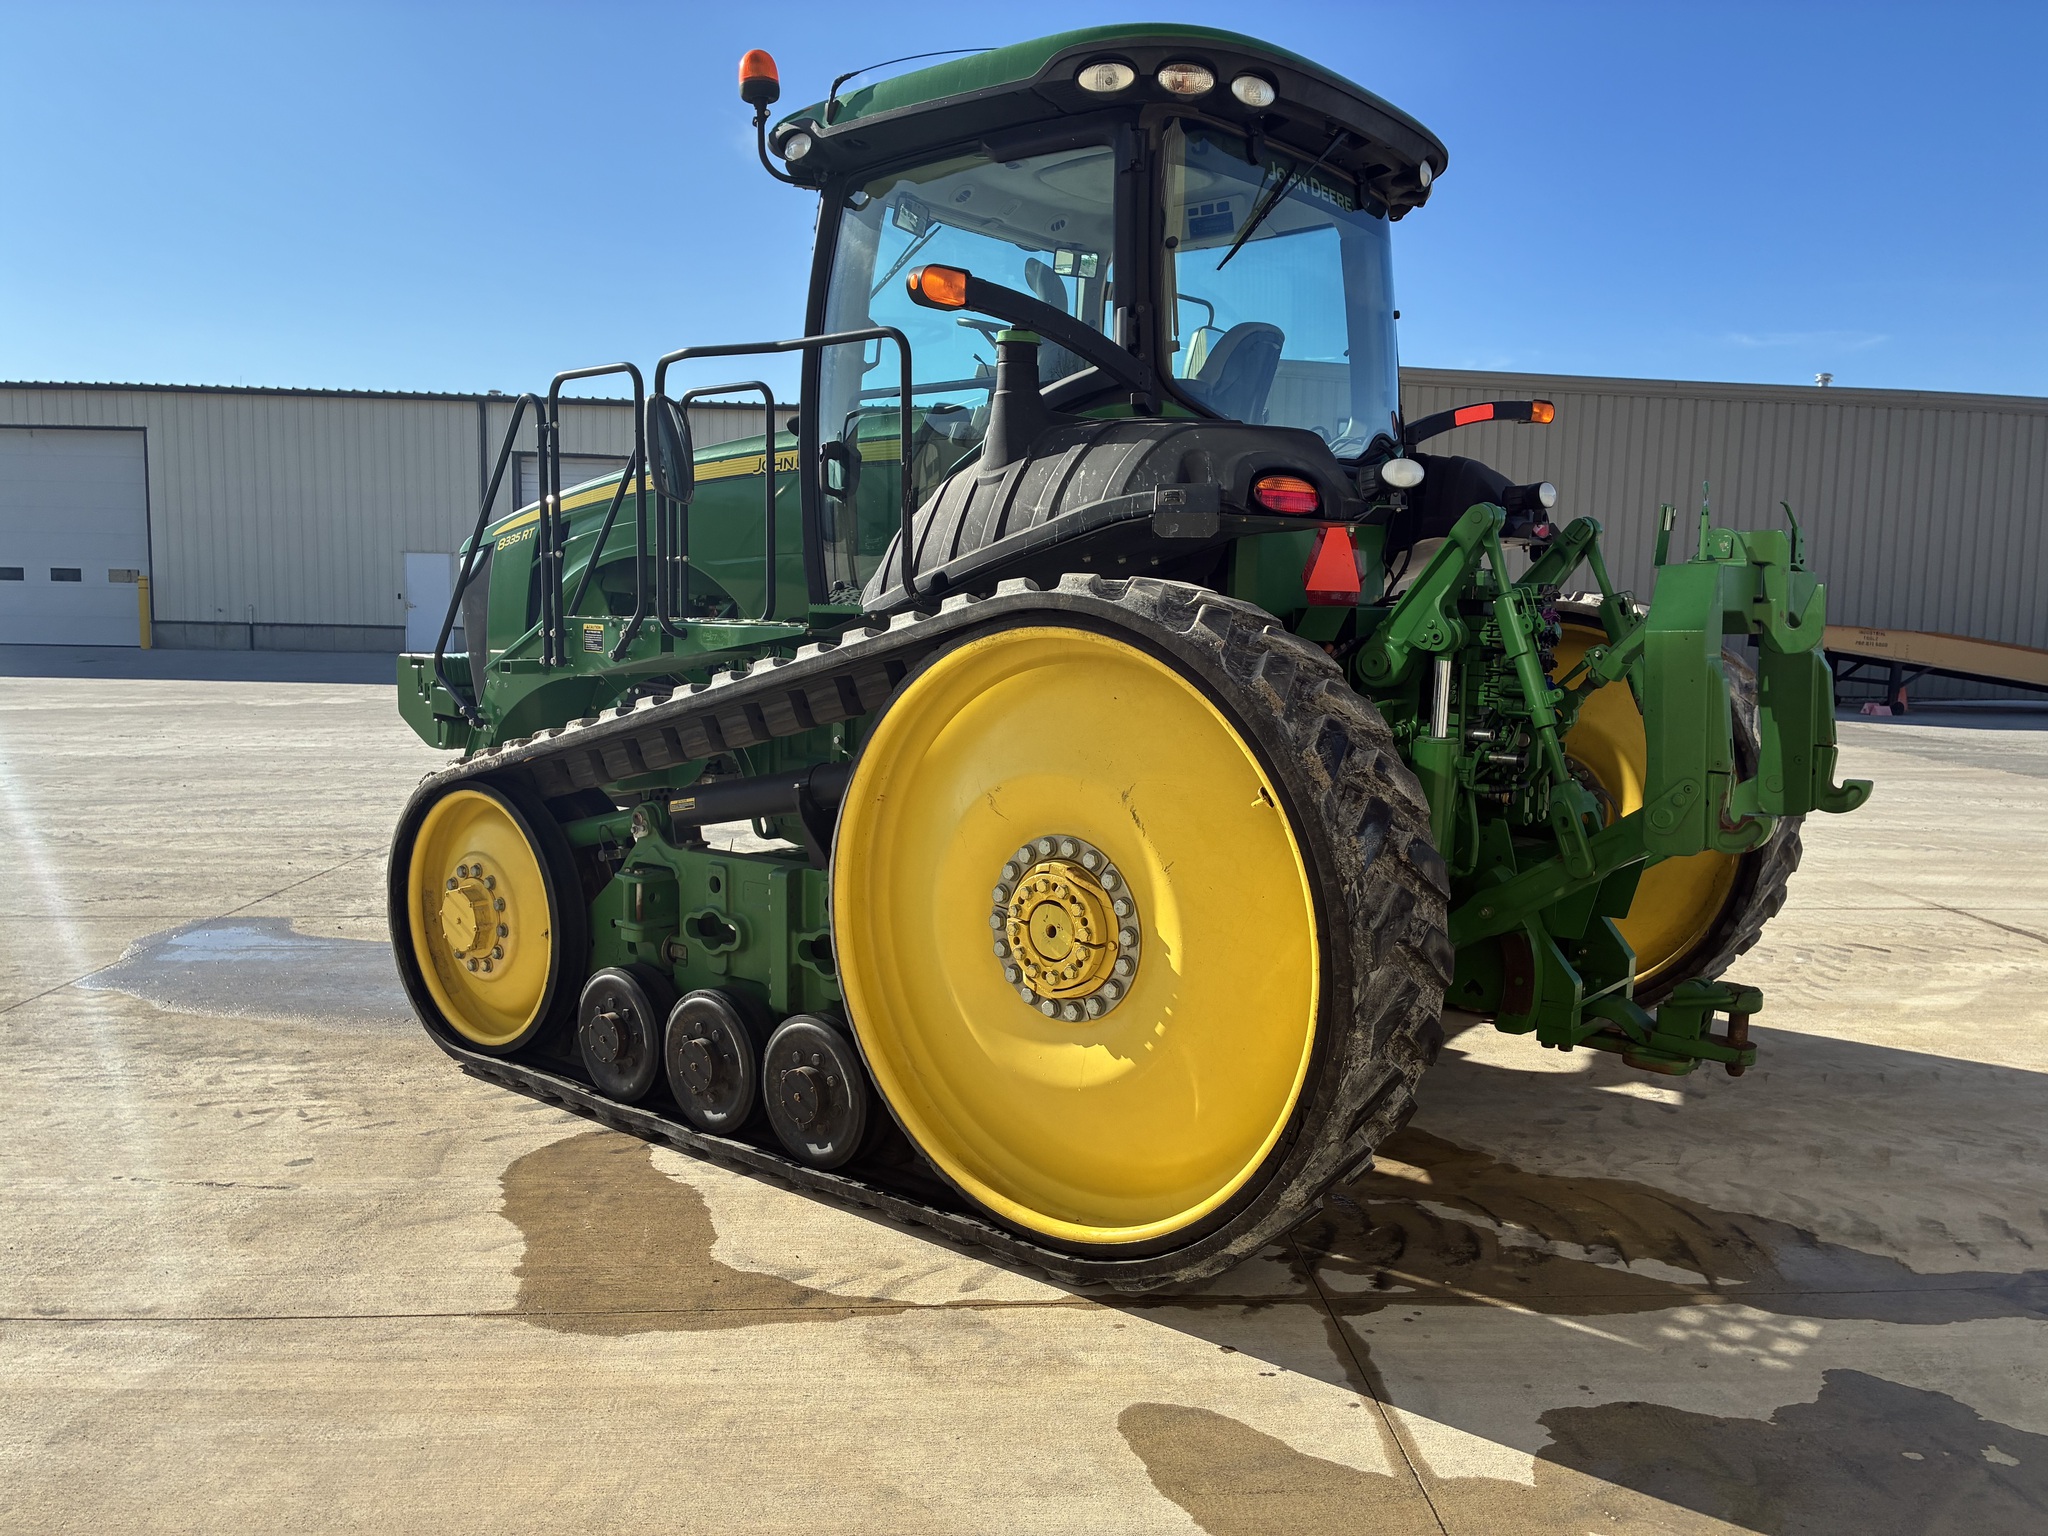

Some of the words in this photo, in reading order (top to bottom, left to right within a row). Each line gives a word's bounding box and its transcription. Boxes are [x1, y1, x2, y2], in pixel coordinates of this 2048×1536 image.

[1310, 176, 1353, 213] DEERE
[497, 532, 521, 551] 8335
[521, 527, 536, 541] RT
